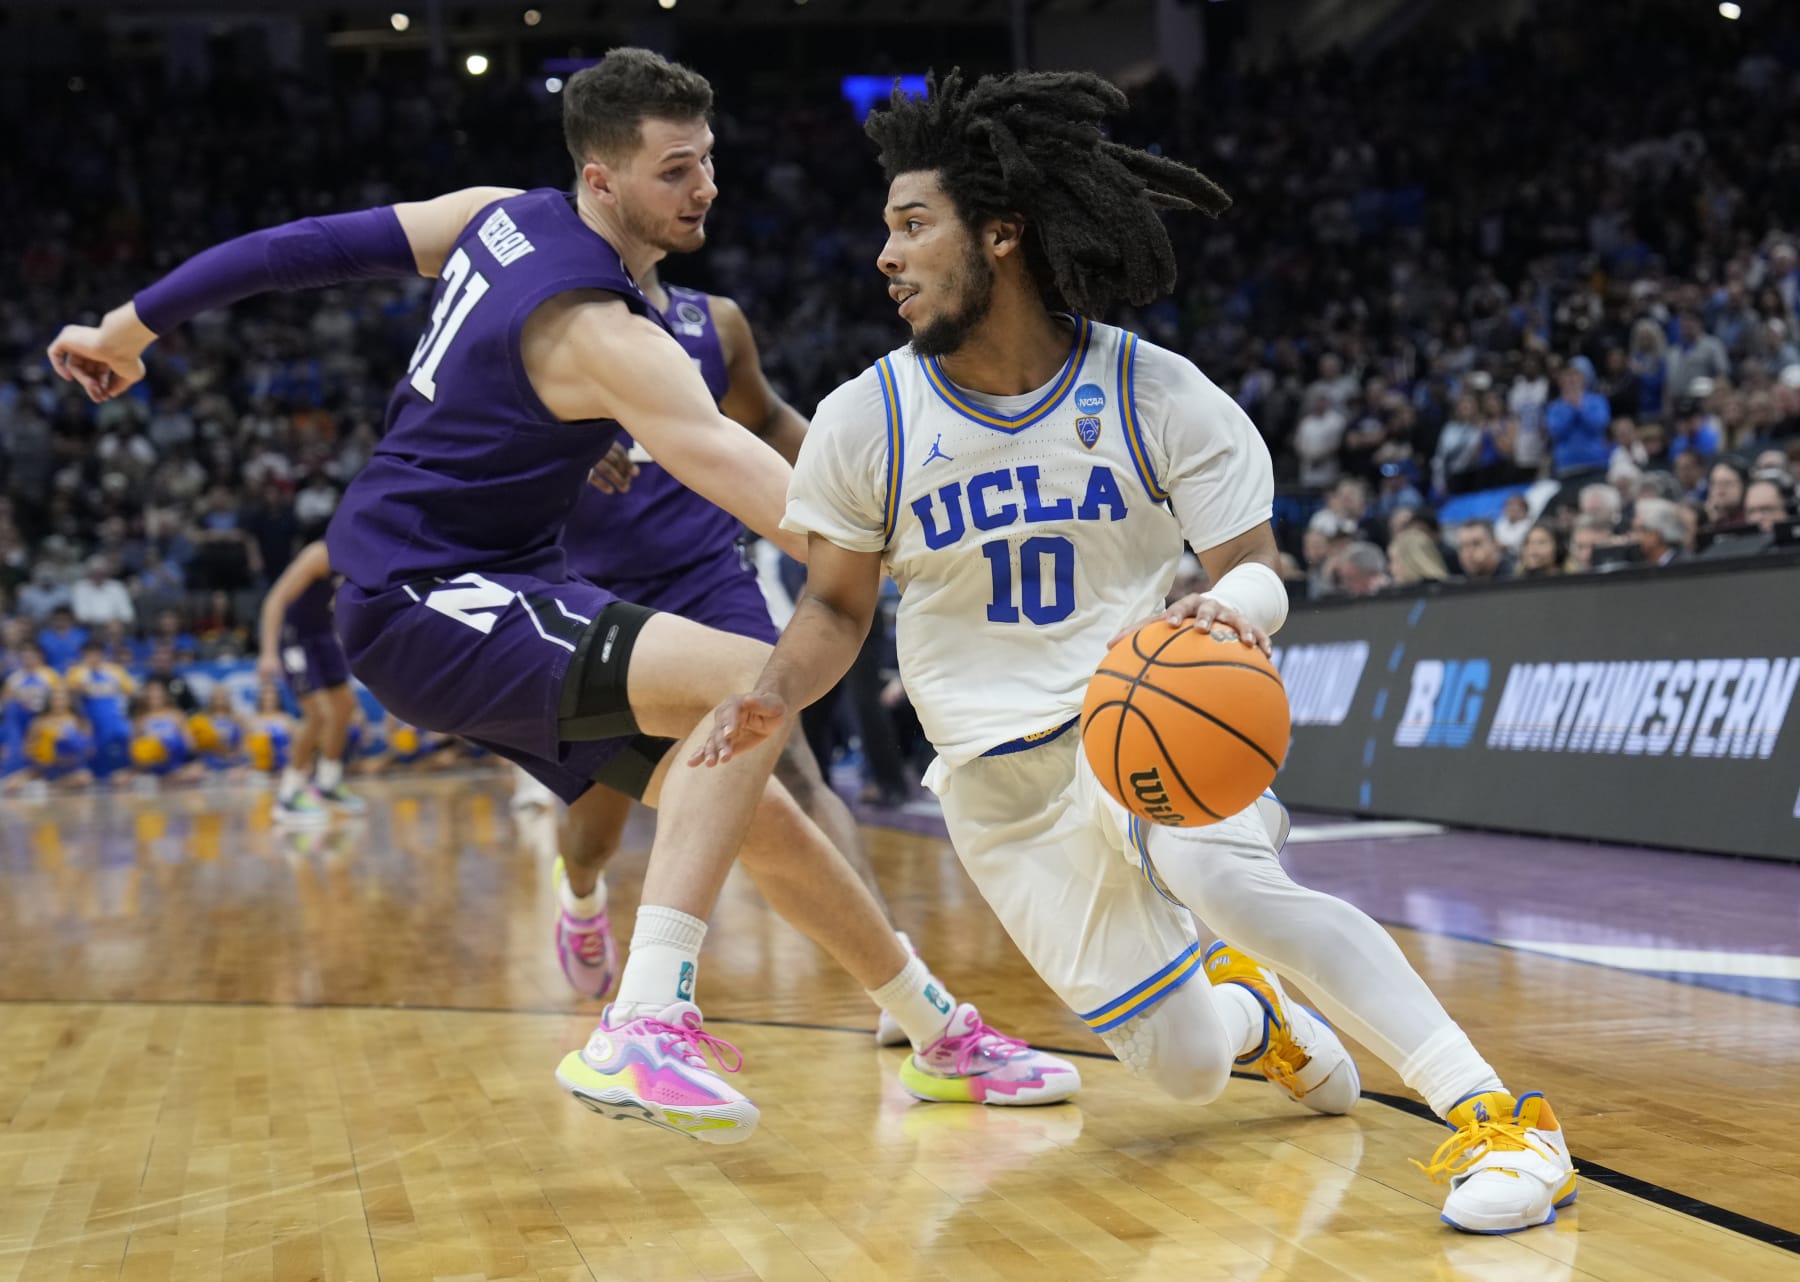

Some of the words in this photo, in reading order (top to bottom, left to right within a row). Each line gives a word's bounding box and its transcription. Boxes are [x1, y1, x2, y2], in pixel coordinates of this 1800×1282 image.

[407, 247, 490, 402] 31
[1079, 397, 1104, 408] NCAA
[1083, 429, 1096, 442] 12
[911, 465, 1128, 551] UCLA
[982, 536, 1075, 625] 10
[1487, 656, 1800, 760] NORTHWESTERN
[1129, 767, 1185, 826] Wil
